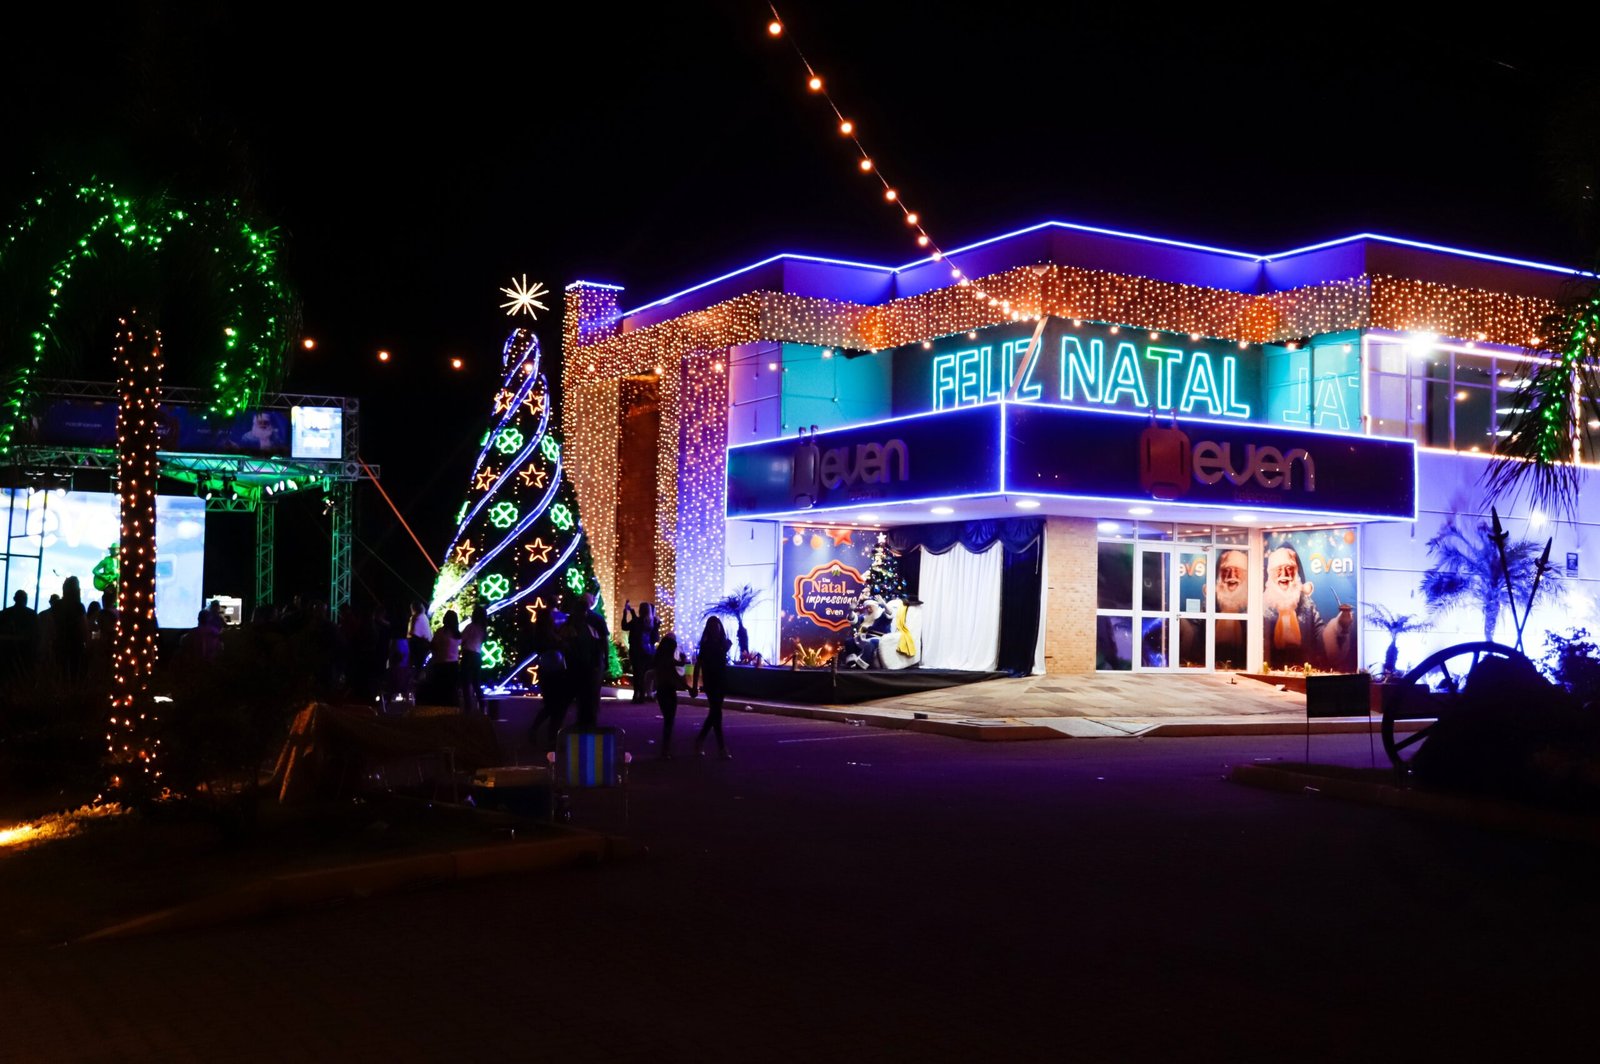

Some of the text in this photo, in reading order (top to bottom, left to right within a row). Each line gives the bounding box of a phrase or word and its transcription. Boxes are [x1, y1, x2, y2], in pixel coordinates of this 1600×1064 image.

[934, 336, 1250, 418] FELIZ NATAL
[821, 438, 909, 490] even
[1192, 440, 1315, 492] even
[1310, 553, 1354, 575] even
[811, 580, 846, 594] Natal
[825, 607, 844, 616] even
